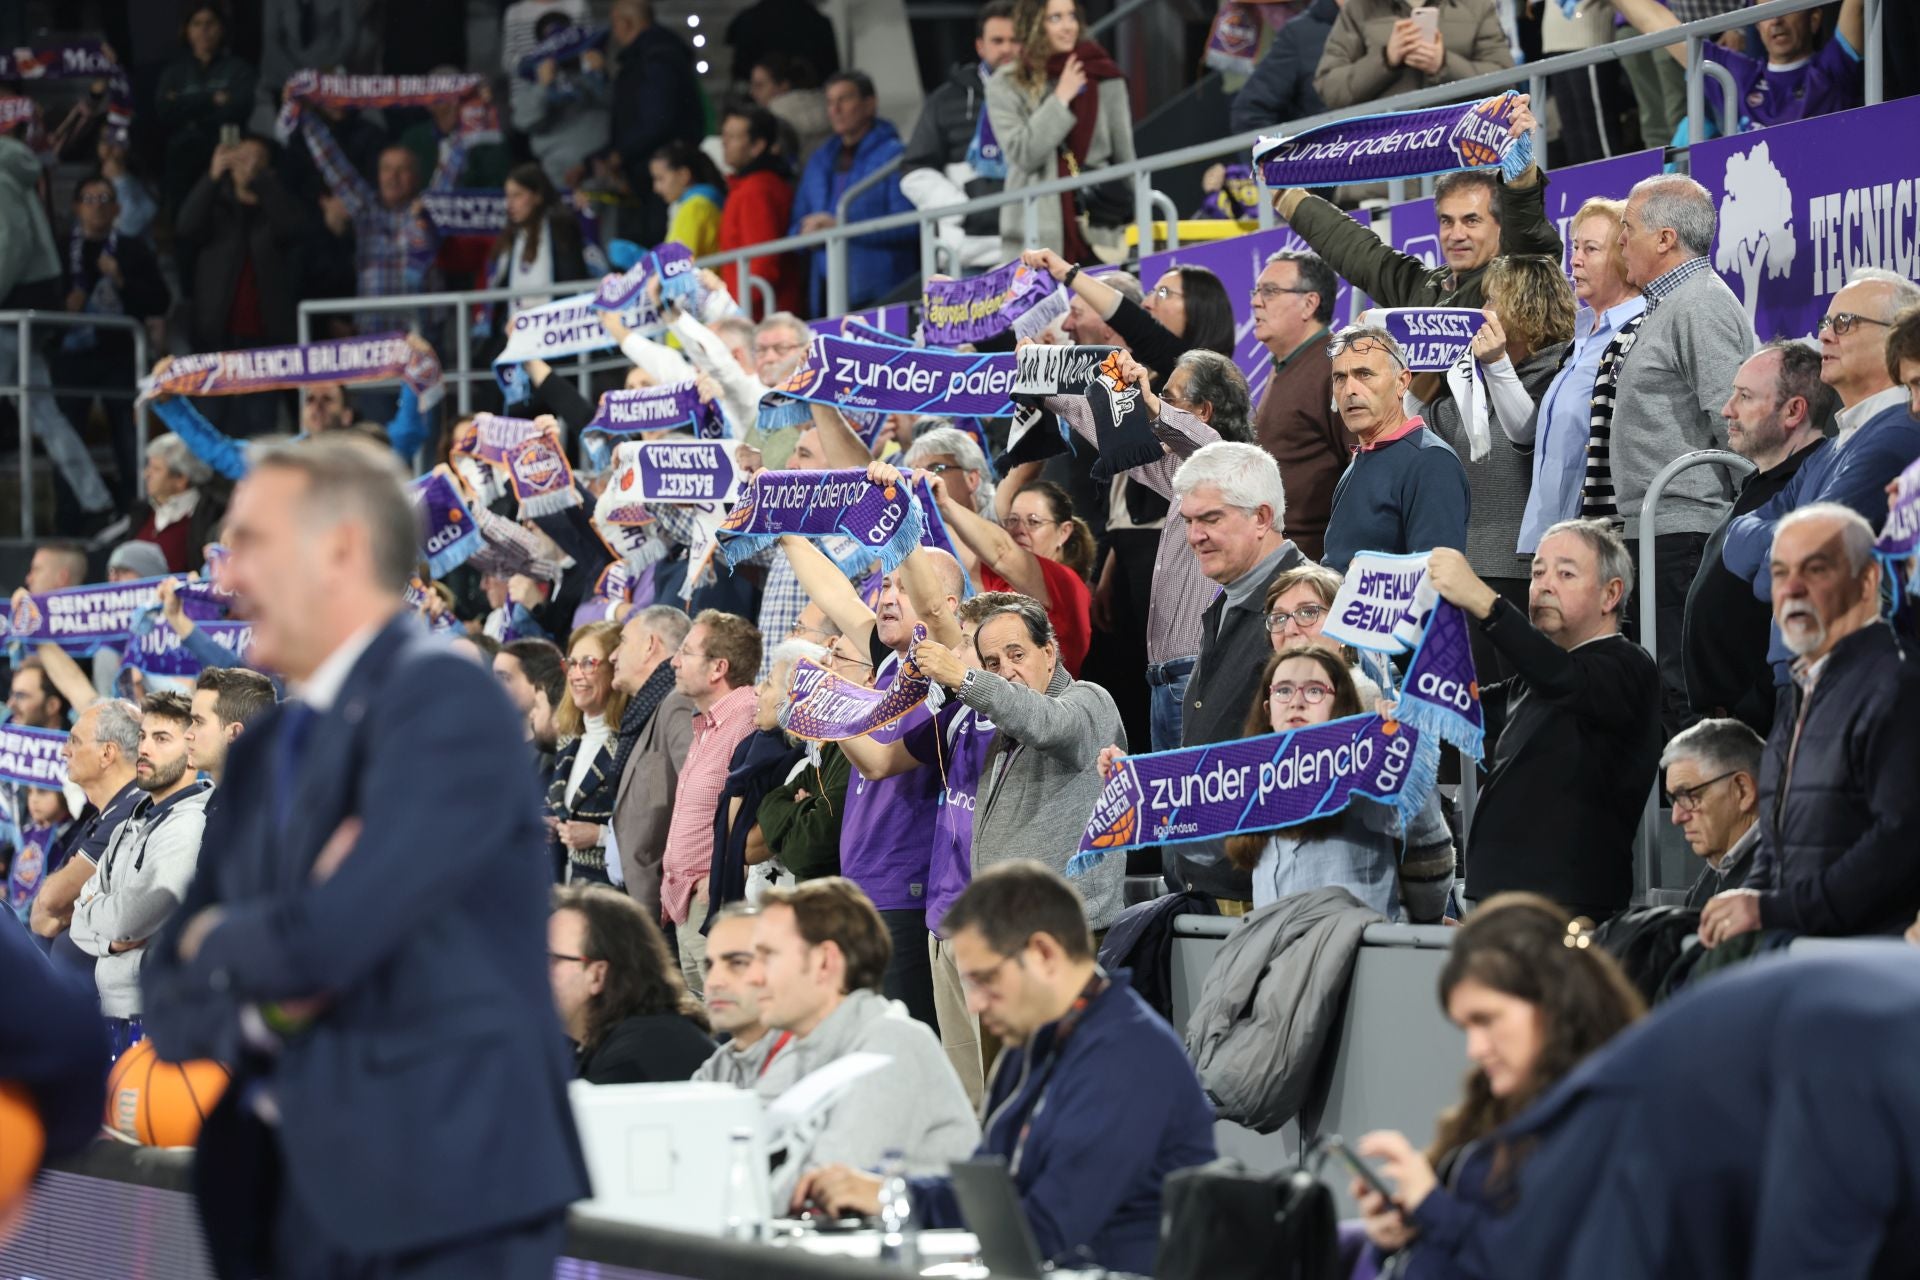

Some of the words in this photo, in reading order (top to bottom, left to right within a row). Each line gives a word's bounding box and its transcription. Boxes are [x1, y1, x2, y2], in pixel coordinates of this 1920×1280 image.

[1273, 133, 1352, 163] zunder
[1403, 313, 1474, 338] BASKET
[226, 350, 303, 381] PALENCIA
[834, 357, 943, 394] zunder
[943, 362, 1019, 402] palen
[609, 397, 679, 423] PALENTINO.
[646, 445, 719, 469] PALENCIA
[657, 473, 714, 497] BASKET
[762, 477, 812, 509] zunder
[809, 475, 872, 517] palencia
[427, 523, 463, 553] acb
[868, 502, 902, 543] acb
[47, 585, 163, 614] SENTIMIE
[1418, 671, 1472, 712] acb
[1150, 759, 1251, 811] zunder
[1259, 732, 1374, 805] palencia
[1375, 735, 1410, 793] acb
[1094, 769, 1133, 815] NDER
[1087, 794, 1132, 839] PALENCIA
